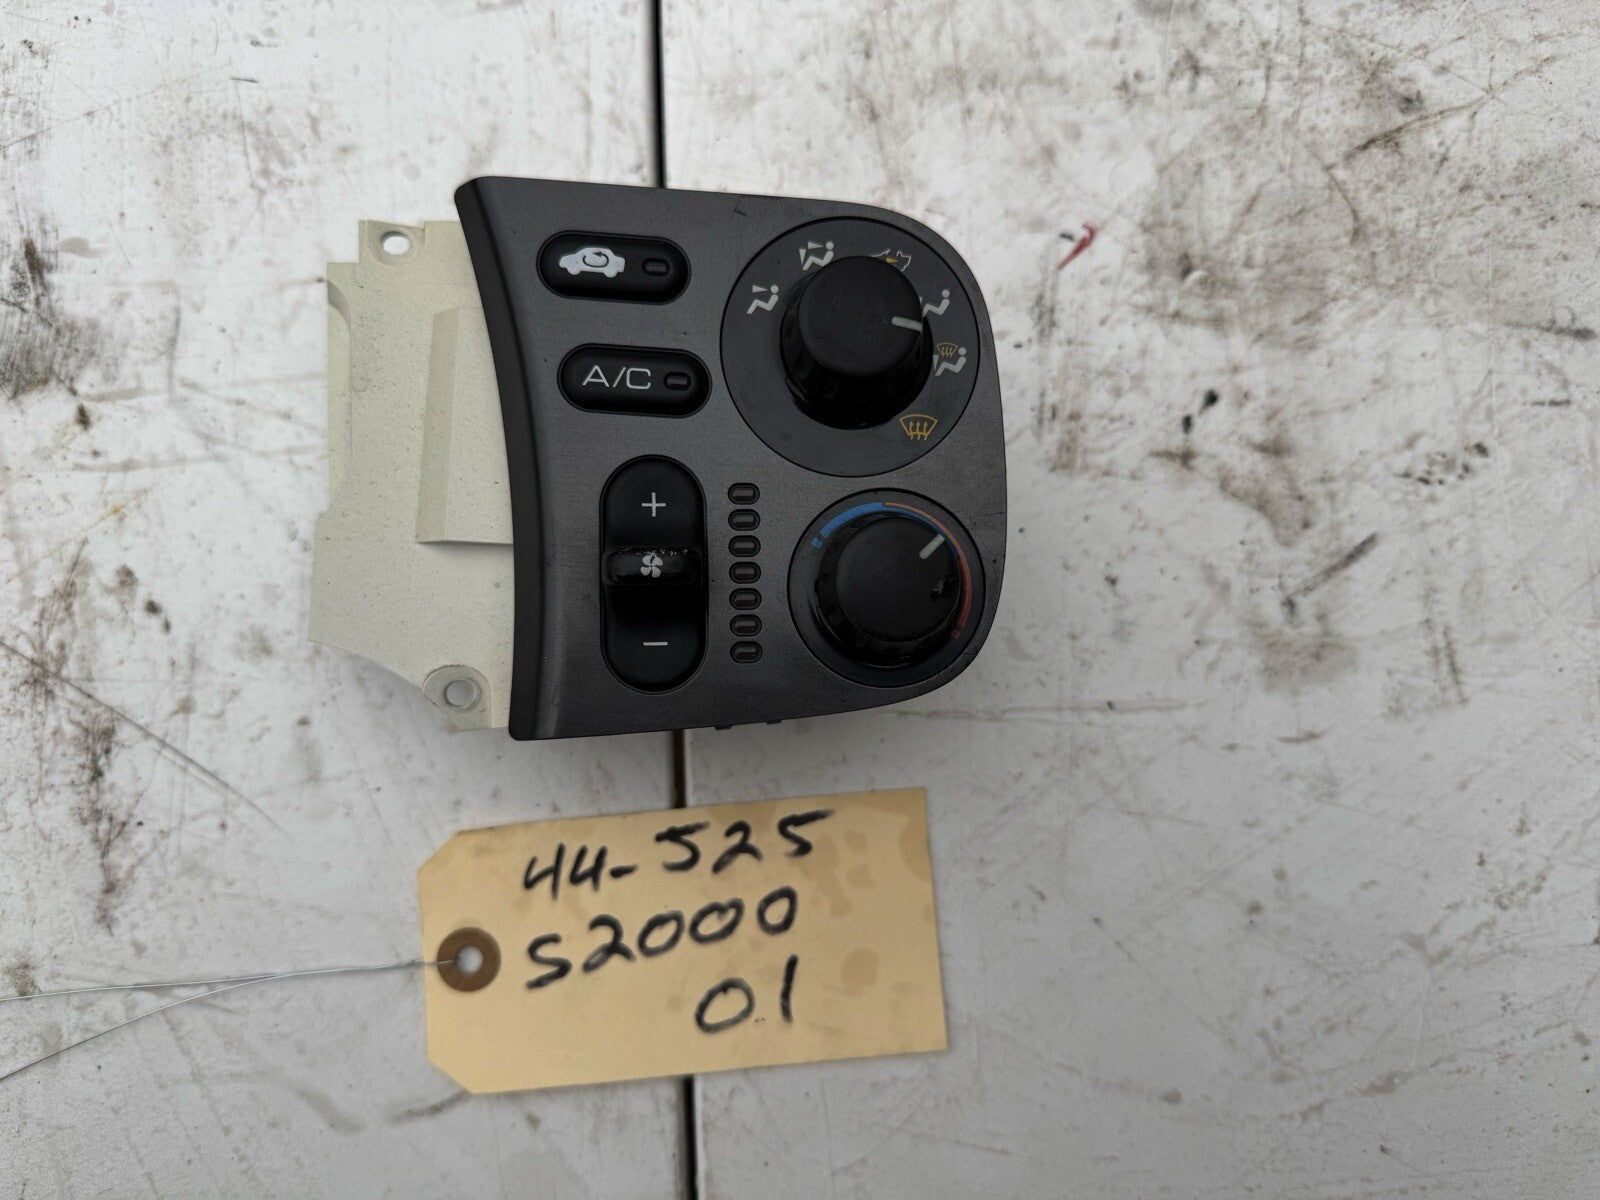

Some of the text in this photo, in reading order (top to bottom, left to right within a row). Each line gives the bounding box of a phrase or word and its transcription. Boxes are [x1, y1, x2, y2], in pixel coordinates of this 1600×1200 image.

[582, 365, 651, 390] A/C
[522, 808, 835, 900] 44-525
[525, 886, 799, 991] S2000
[694, 954, 799, 1033] 01
